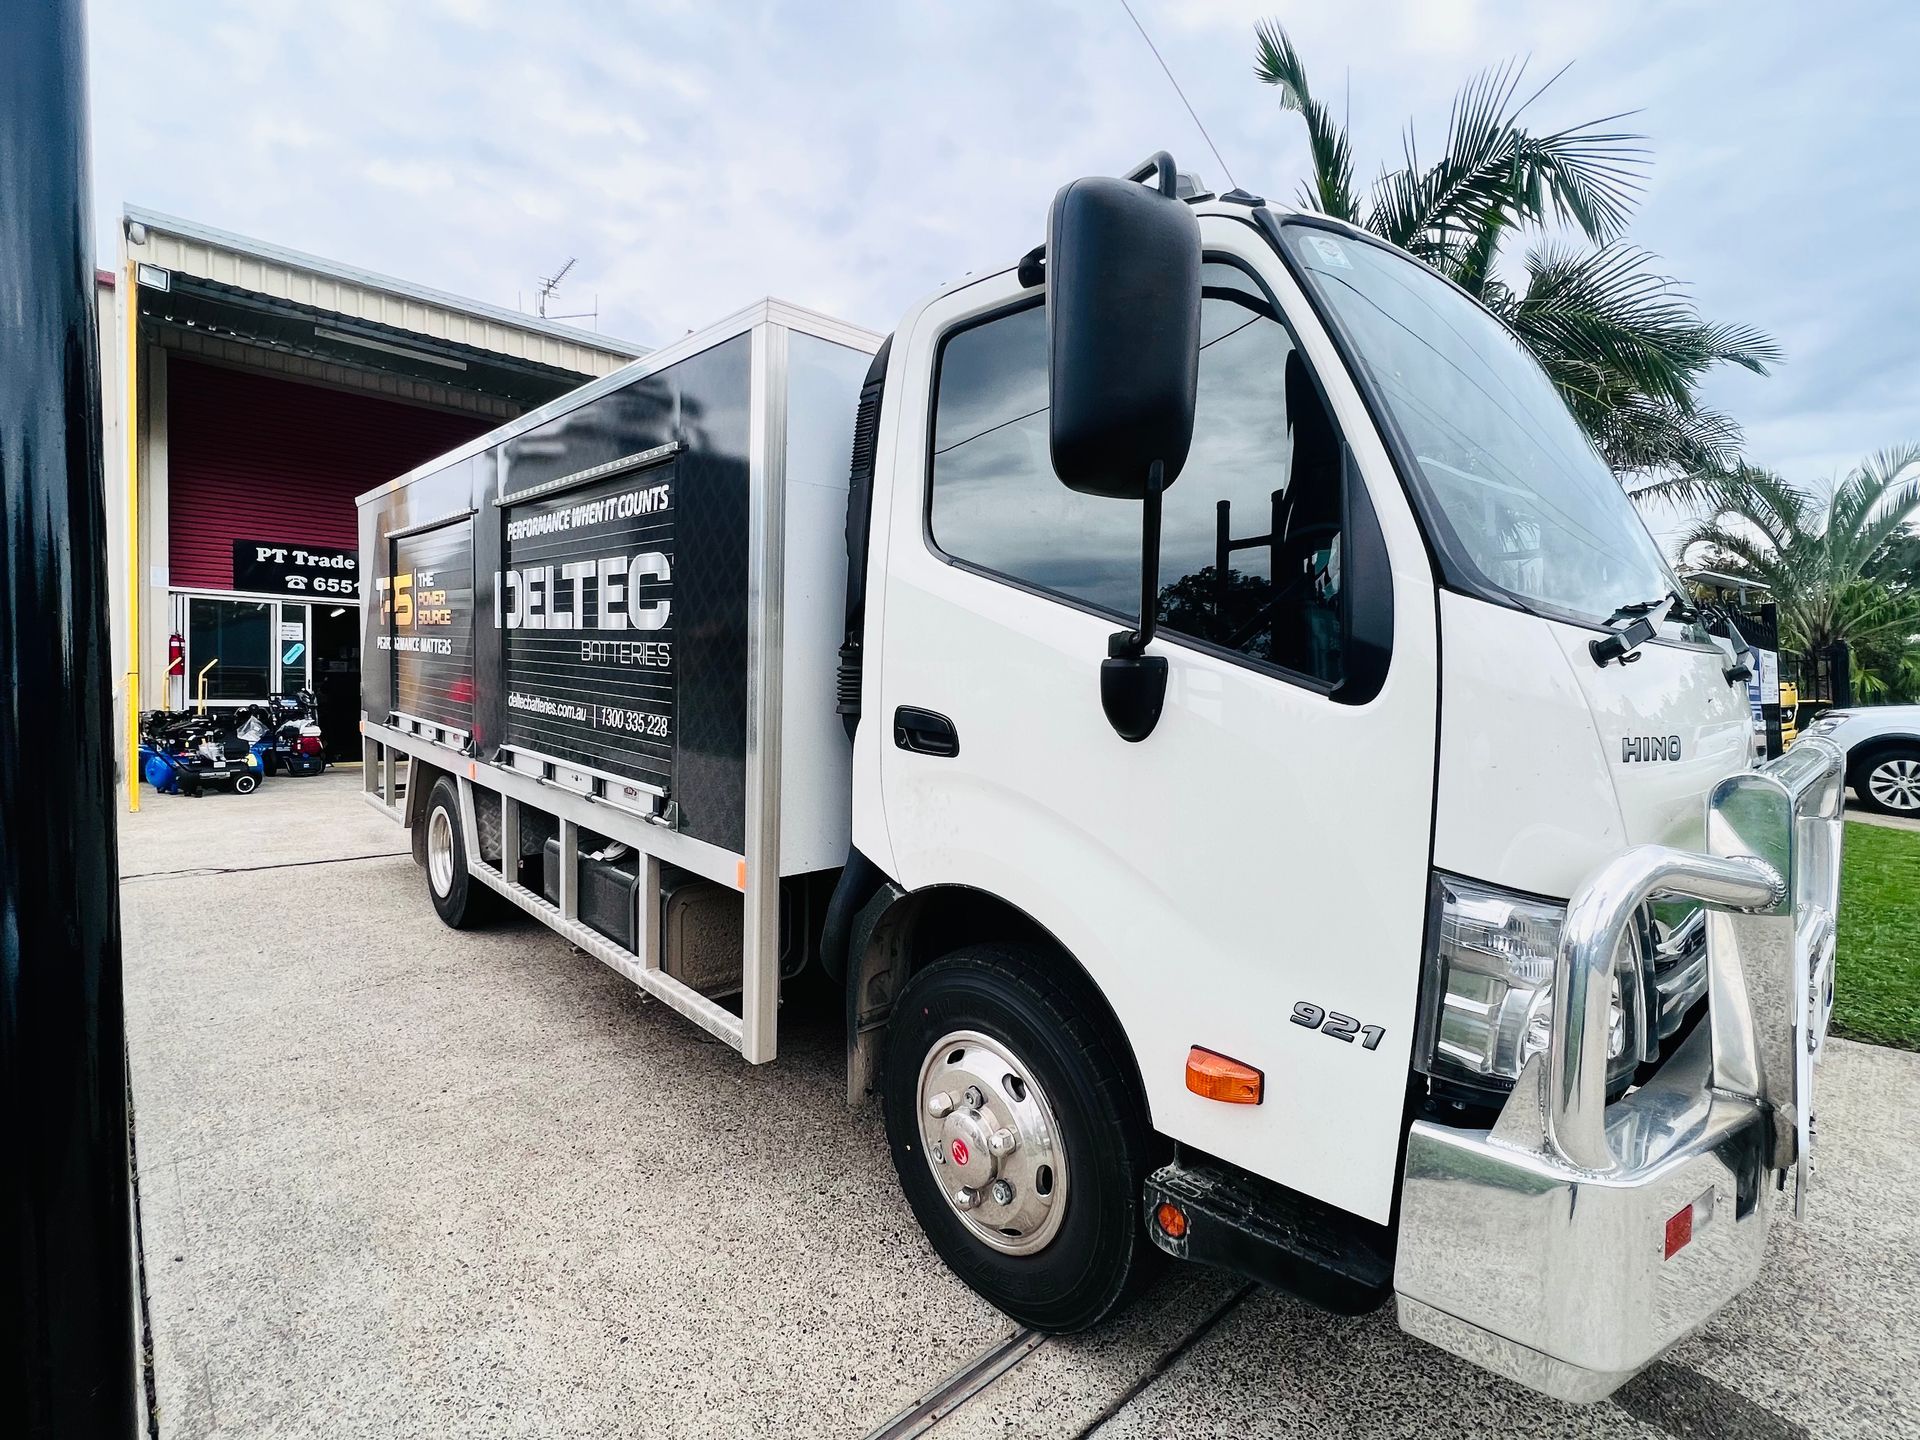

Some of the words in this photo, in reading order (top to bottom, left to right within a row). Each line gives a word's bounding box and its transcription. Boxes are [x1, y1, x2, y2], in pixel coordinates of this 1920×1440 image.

[507, 509, 571, 541] PERFORMANCE
[571, 501, 603, 528] WHEN
[604, 498, 618, 522] IT
[617, 484, 670, 518] COUNTS
[255, 547, 288, 564] PT
[292, 550, 356, 570] Trade
[417, 572, 435, 587] THE
[494, 551, 671, 631] DELTEC
[417, 590, 446, 606] POWER
[418, 609, 452, 625] SOURCE
[420, 637, 452, 655] MATTERS
[581, 640, 671, 668] BATTERIES
[508, 692, 587, 722] deltecbatteries.com.au
[601, 706, 624, 729] 1300
[625, 713, 645, 734] 335
[646, 716, 669, 738] 228
[1621, 735, 1682, 763] HINO
[1289, 1000, 1387, 1052] 921
